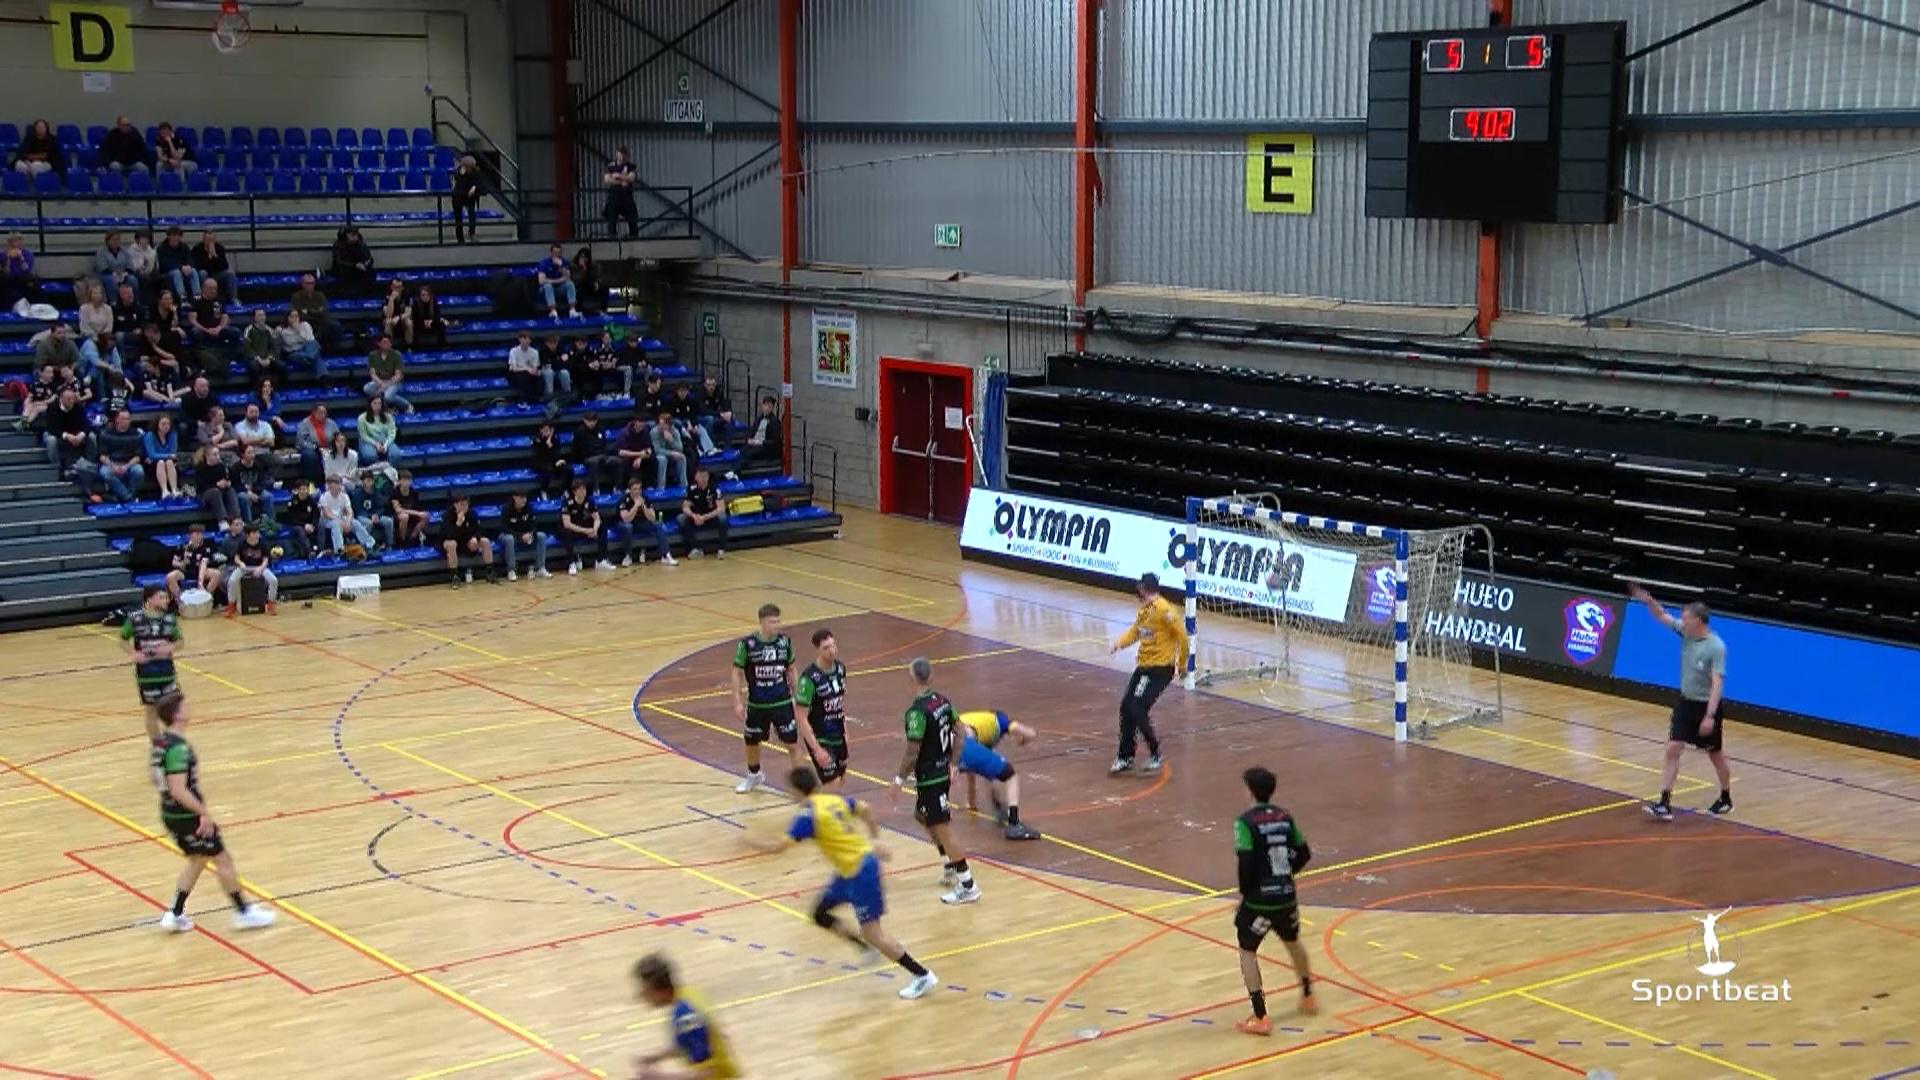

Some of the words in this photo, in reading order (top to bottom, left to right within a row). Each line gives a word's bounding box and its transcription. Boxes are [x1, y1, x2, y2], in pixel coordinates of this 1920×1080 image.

[70, 12, 114, 62] D
[1446, 39, 1460, 70] 5
[1526, 35, 1541, 68] 5
[665, 101, 702, 120] UITGANG
[1264, 143, 1295, 203] E
[993, 501, 1111, 554] OLYMPIA
